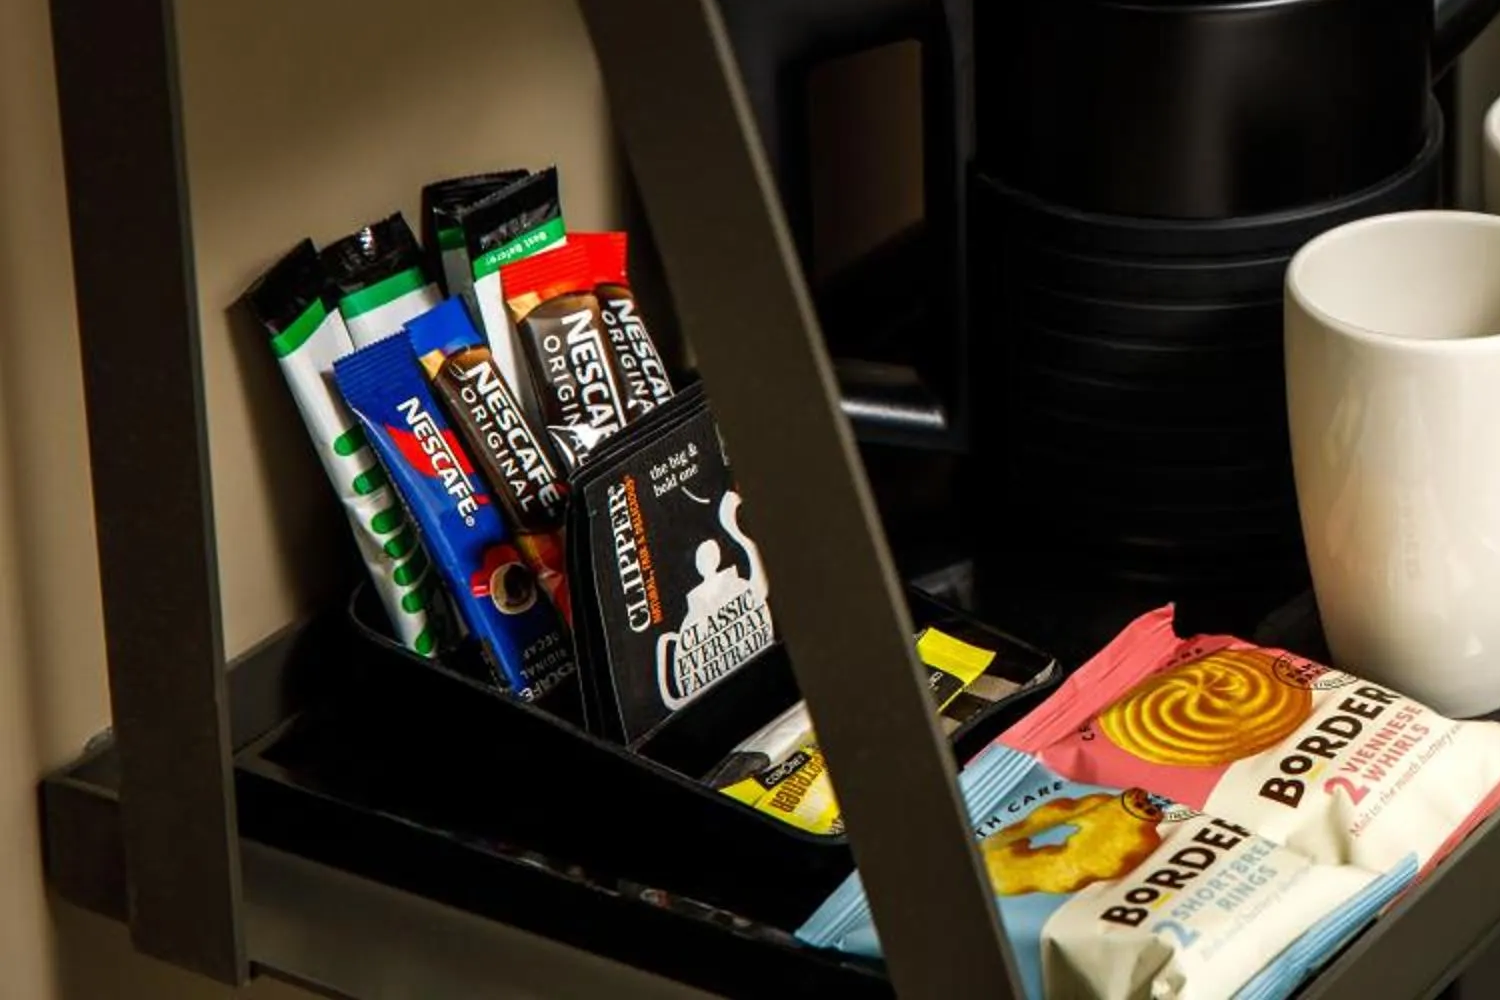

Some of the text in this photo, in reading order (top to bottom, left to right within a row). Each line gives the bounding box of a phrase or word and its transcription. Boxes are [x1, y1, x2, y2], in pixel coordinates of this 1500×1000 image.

[561, 308, 622, 438] NESCAF
[601, 309, 655, 415] ORIGINA
[607, 299, 672, 406] NESCA
[461, 386, 536, 513] ORIGINAL
[649, 461, 669, 482] the
[668, 448, 689, 472] big
[679, 463, 699, 484] one
[607, 484, 651, 633] CLIPPER
[678, 606, 767, 677] EVERYDAY
[680, 589, 756, 651] CLASSIC
[680, 626, 773, 697] FAIRTRADE
[1258, 686, 1403, 809] BORDER
[1323, 704, 1423, 806] 2 VIENNESE
[1361, 724, 1430, 783] WHIRLS
[974, 780, 1065, 839] TH CARE
[1215, 865, 1279, 914] RINGS
[1151, 919, 1199, 949] 2
